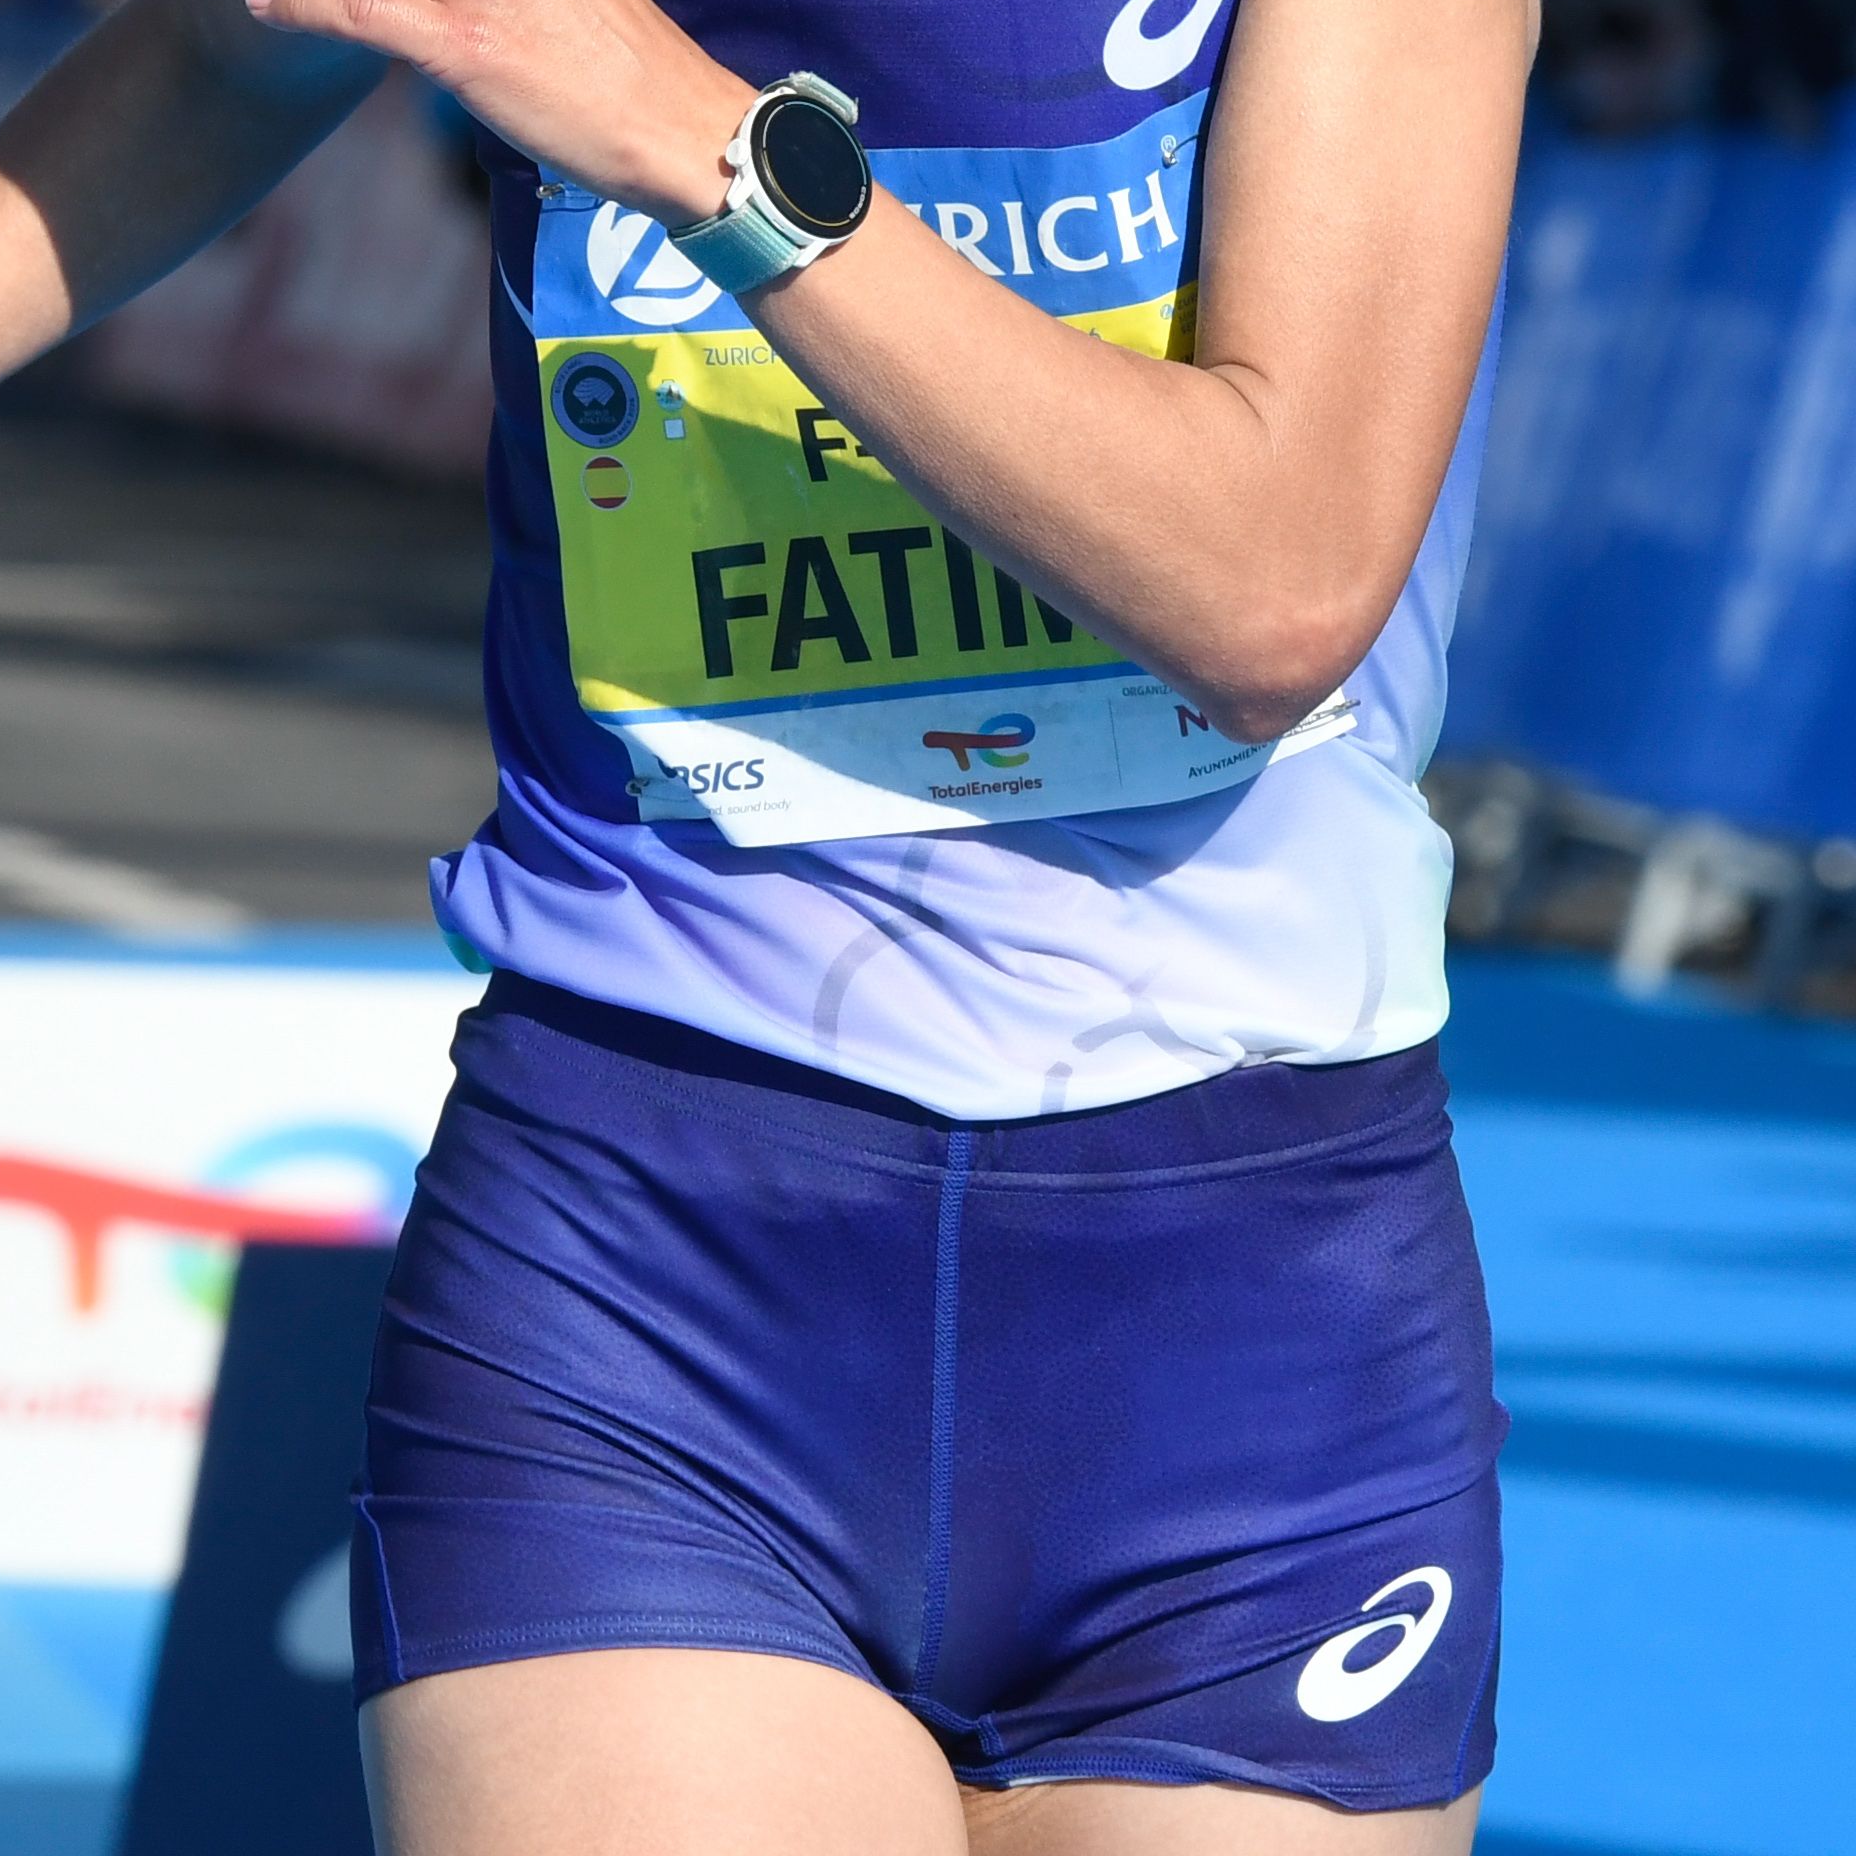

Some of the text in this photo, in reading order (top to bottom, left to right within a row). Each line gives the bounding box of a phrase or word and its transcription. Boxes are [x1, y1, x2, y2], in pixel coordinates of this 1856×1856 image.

[904, 169, 1179, 276] RICH
[1121, 684, 1173, 697] ORGANIZ
[928, 776, 1043, 800] TotalEnergies
